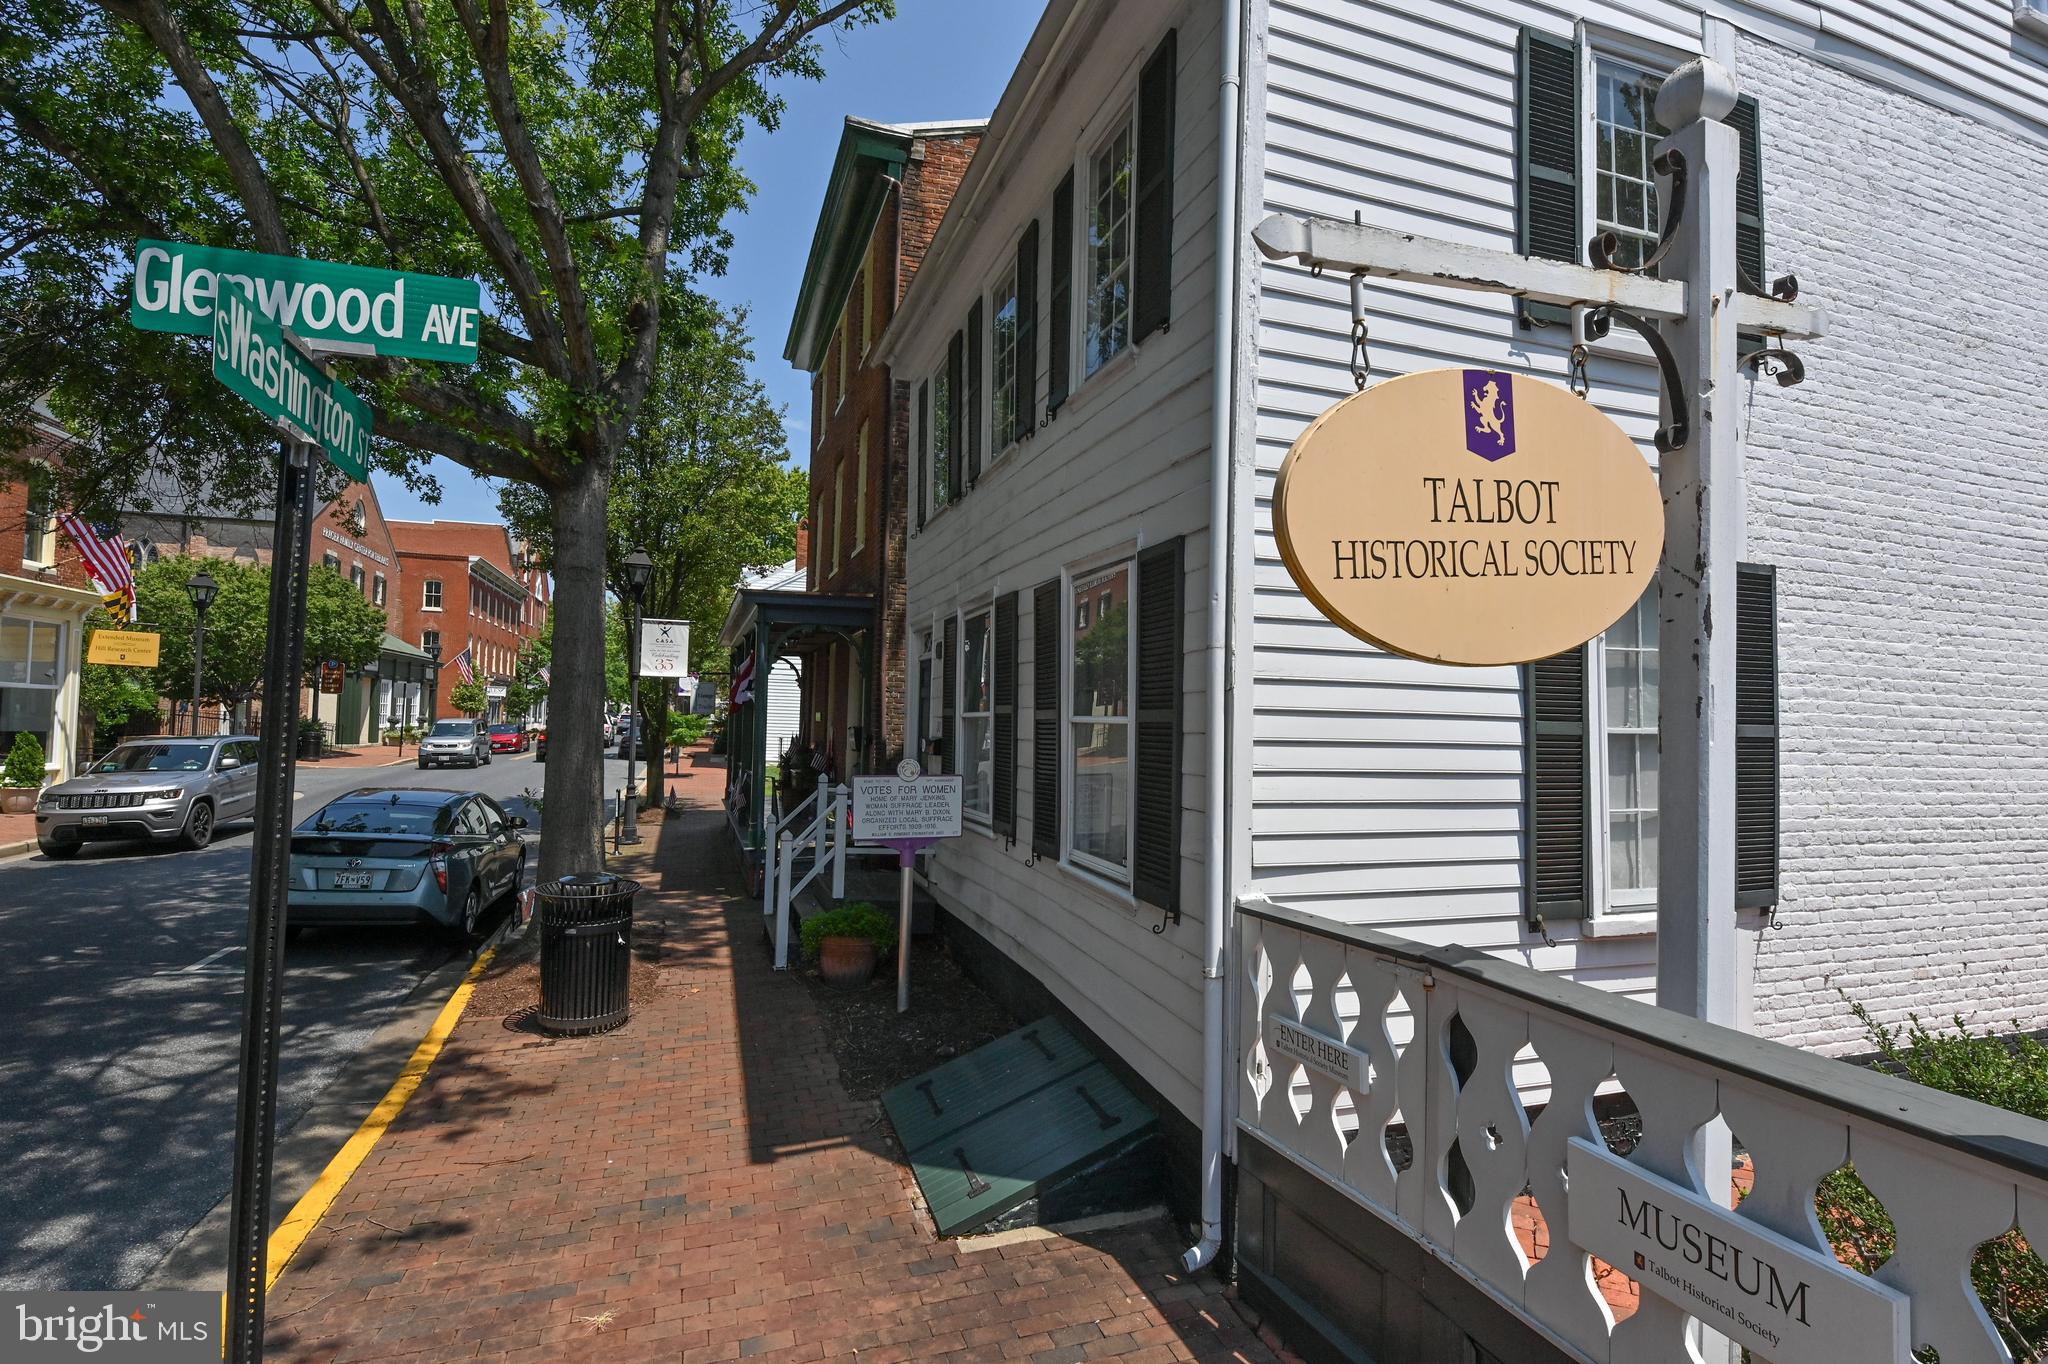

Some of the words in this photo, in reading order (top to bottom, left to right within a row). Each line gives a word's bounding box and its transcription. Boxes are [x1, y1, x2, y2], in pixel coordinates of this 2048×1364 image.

[421, 303, 478, 347] AVE
[216, 308, 230, 361] S
[230, 295, 354, 457] Washington
[357, 429, 370, 465] ST
[1423, 477, 1560, 524] TALBOT
[1332, 540, 1519, 580] HISTORICAL
[1525, 539, 1637, 576] SOCIETY
[655, 658, 674, 671] 35
[860, 785, 892, 795] VOTES
[898, 785, 917, 795] FOR
[922, 785, 956, 794] WOMEN
[1279, 1024, 1316, 1054] ENTER
[1317, 1041, 1349, 1070] HERE
[1617, 1187, 1812, 1328] MUSEUM
[1648, 1258, 1680, 1289] Talbot
[1681, 1278, 1736, 1322] Historical
[1737, 1311, 1781, 1348] Society
